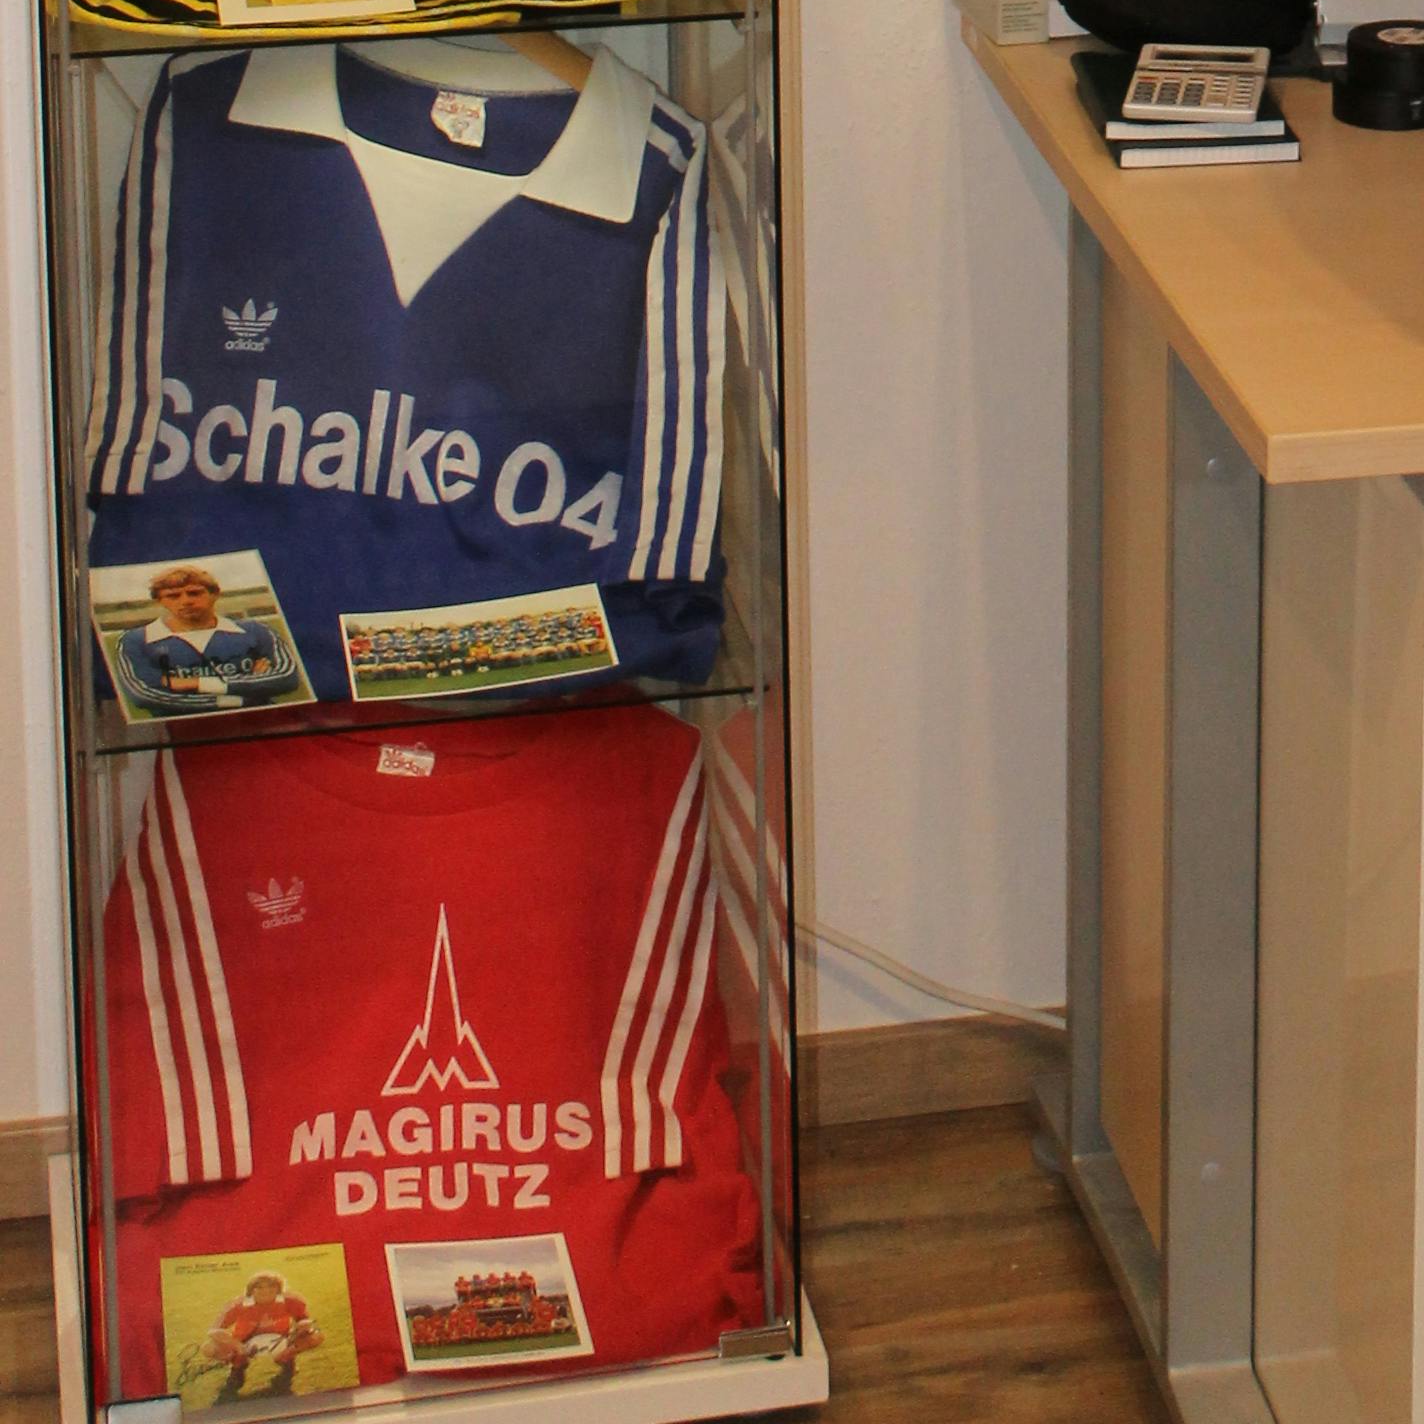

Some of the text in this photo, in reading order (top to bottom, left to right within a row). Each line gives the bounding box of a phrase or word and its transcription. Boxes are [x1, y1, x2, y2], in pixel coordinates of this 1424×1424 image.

[224, 337, 266, 352] adidas
[151, 376, 482, 506] Schalke
[262, 912, 304, 929] adidas
[288, 1100, 594, 1167] MAGIRUS
[333, 1161, 551, 1217] DEUTZ
